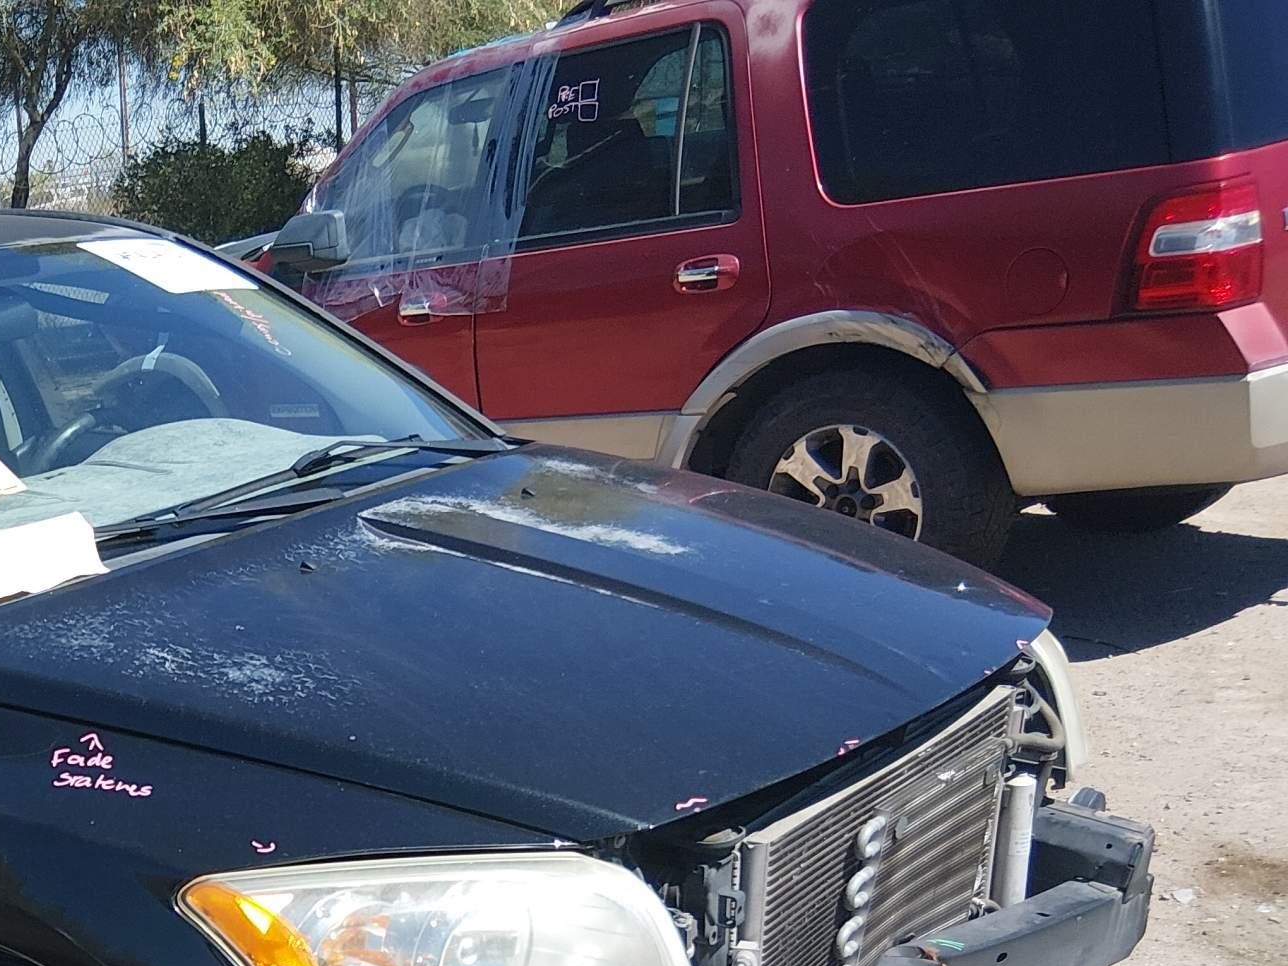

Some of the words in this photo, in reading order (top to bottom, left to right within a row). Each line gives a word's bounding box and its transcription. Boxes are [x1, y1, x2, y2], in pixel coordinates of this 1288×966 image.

[557, 85, 579, 103] PRE
[548, 102, 579, 119] POST
[51, 748, 113, 769] Fade
